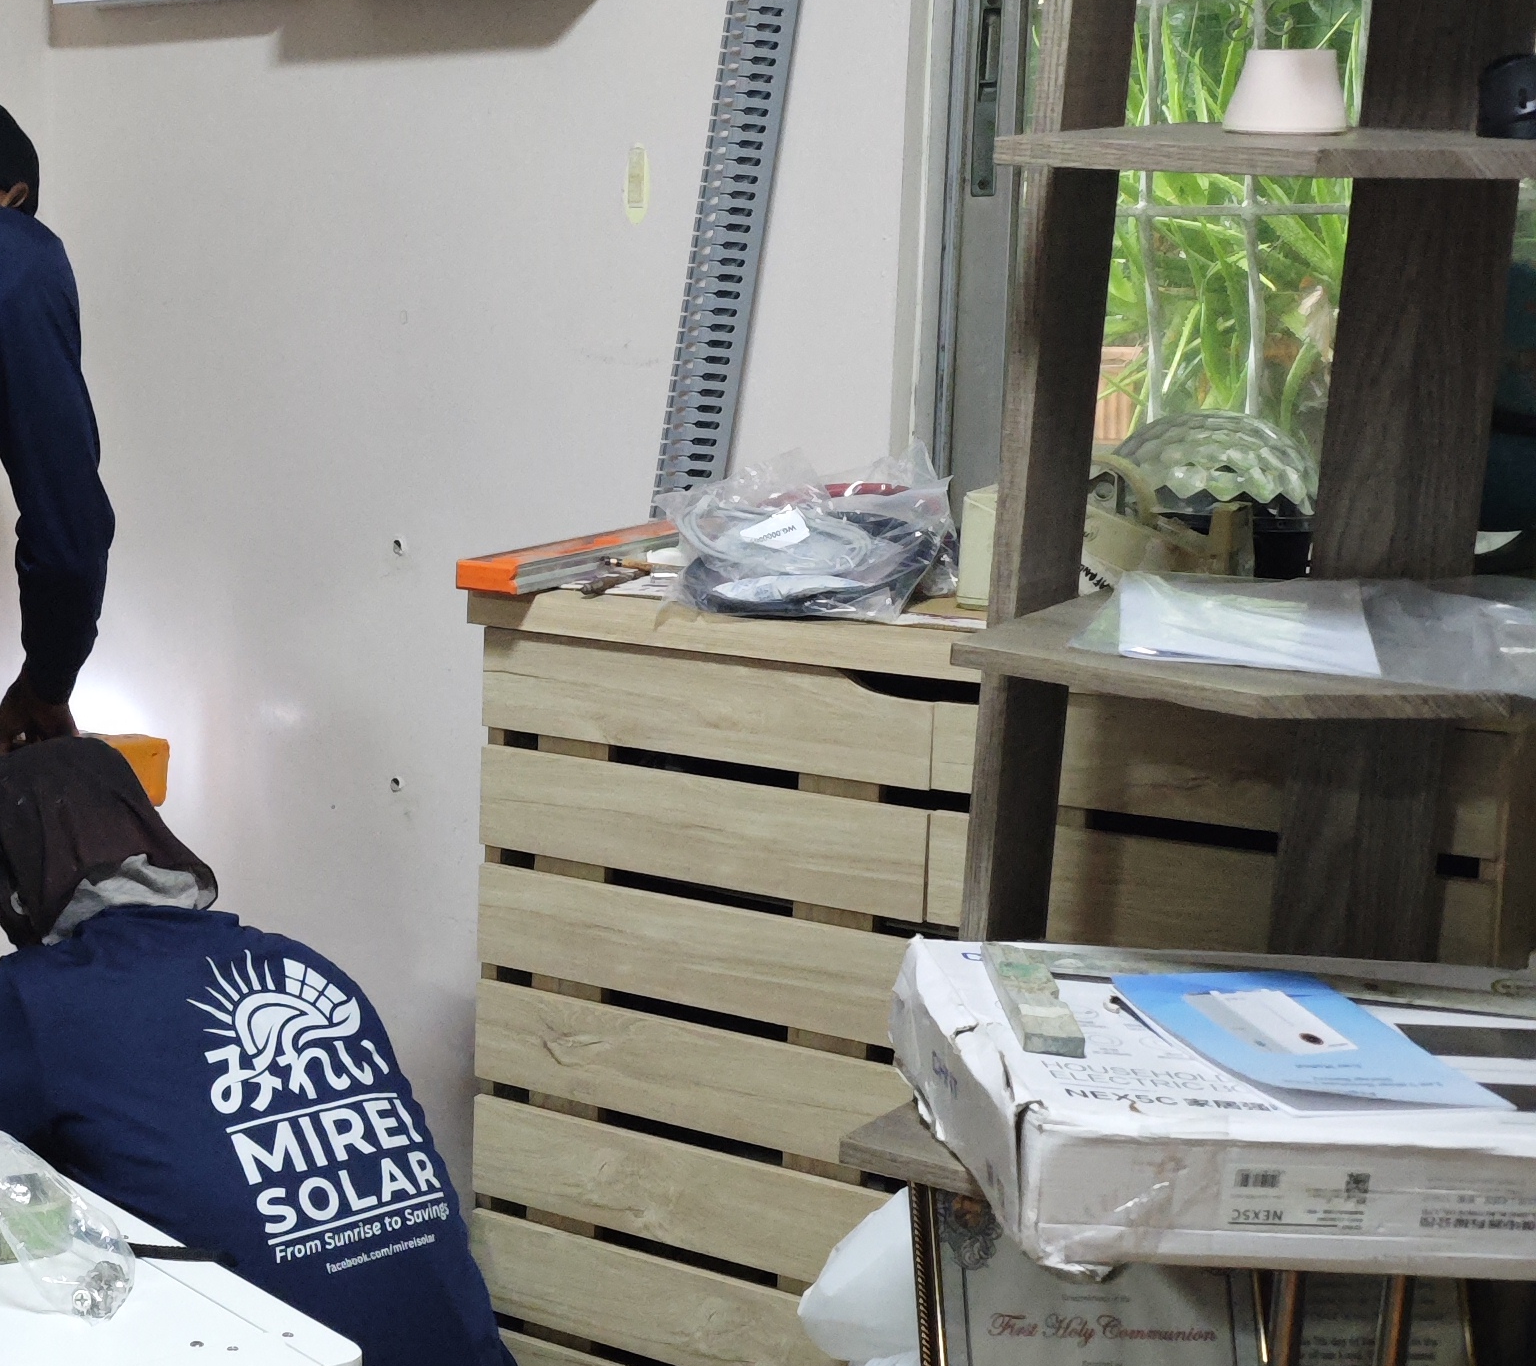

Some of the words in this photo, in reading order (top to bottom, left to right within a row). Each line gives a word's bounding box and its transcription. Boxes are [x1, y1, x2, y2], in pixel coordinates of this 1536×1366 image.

[1049, 1070, 1204, 1092] ELECTRIC
[230, 1099, 423, 1185] MIREI
[255, 1151, 442, 1234] SOLAR
[275, 1238, 322, 1264] From
[325, 1222, 382, 1250] Sunrise
[385, 1216, 402, 1232] to
[405, 1201, 450, 1226] Savings
[326, 1233, 436, 1275] facebook.com/mireisolar
[1042, 1312, 1096, 1348] Holy
[1096, 1315, 1217, 1341] Communion
